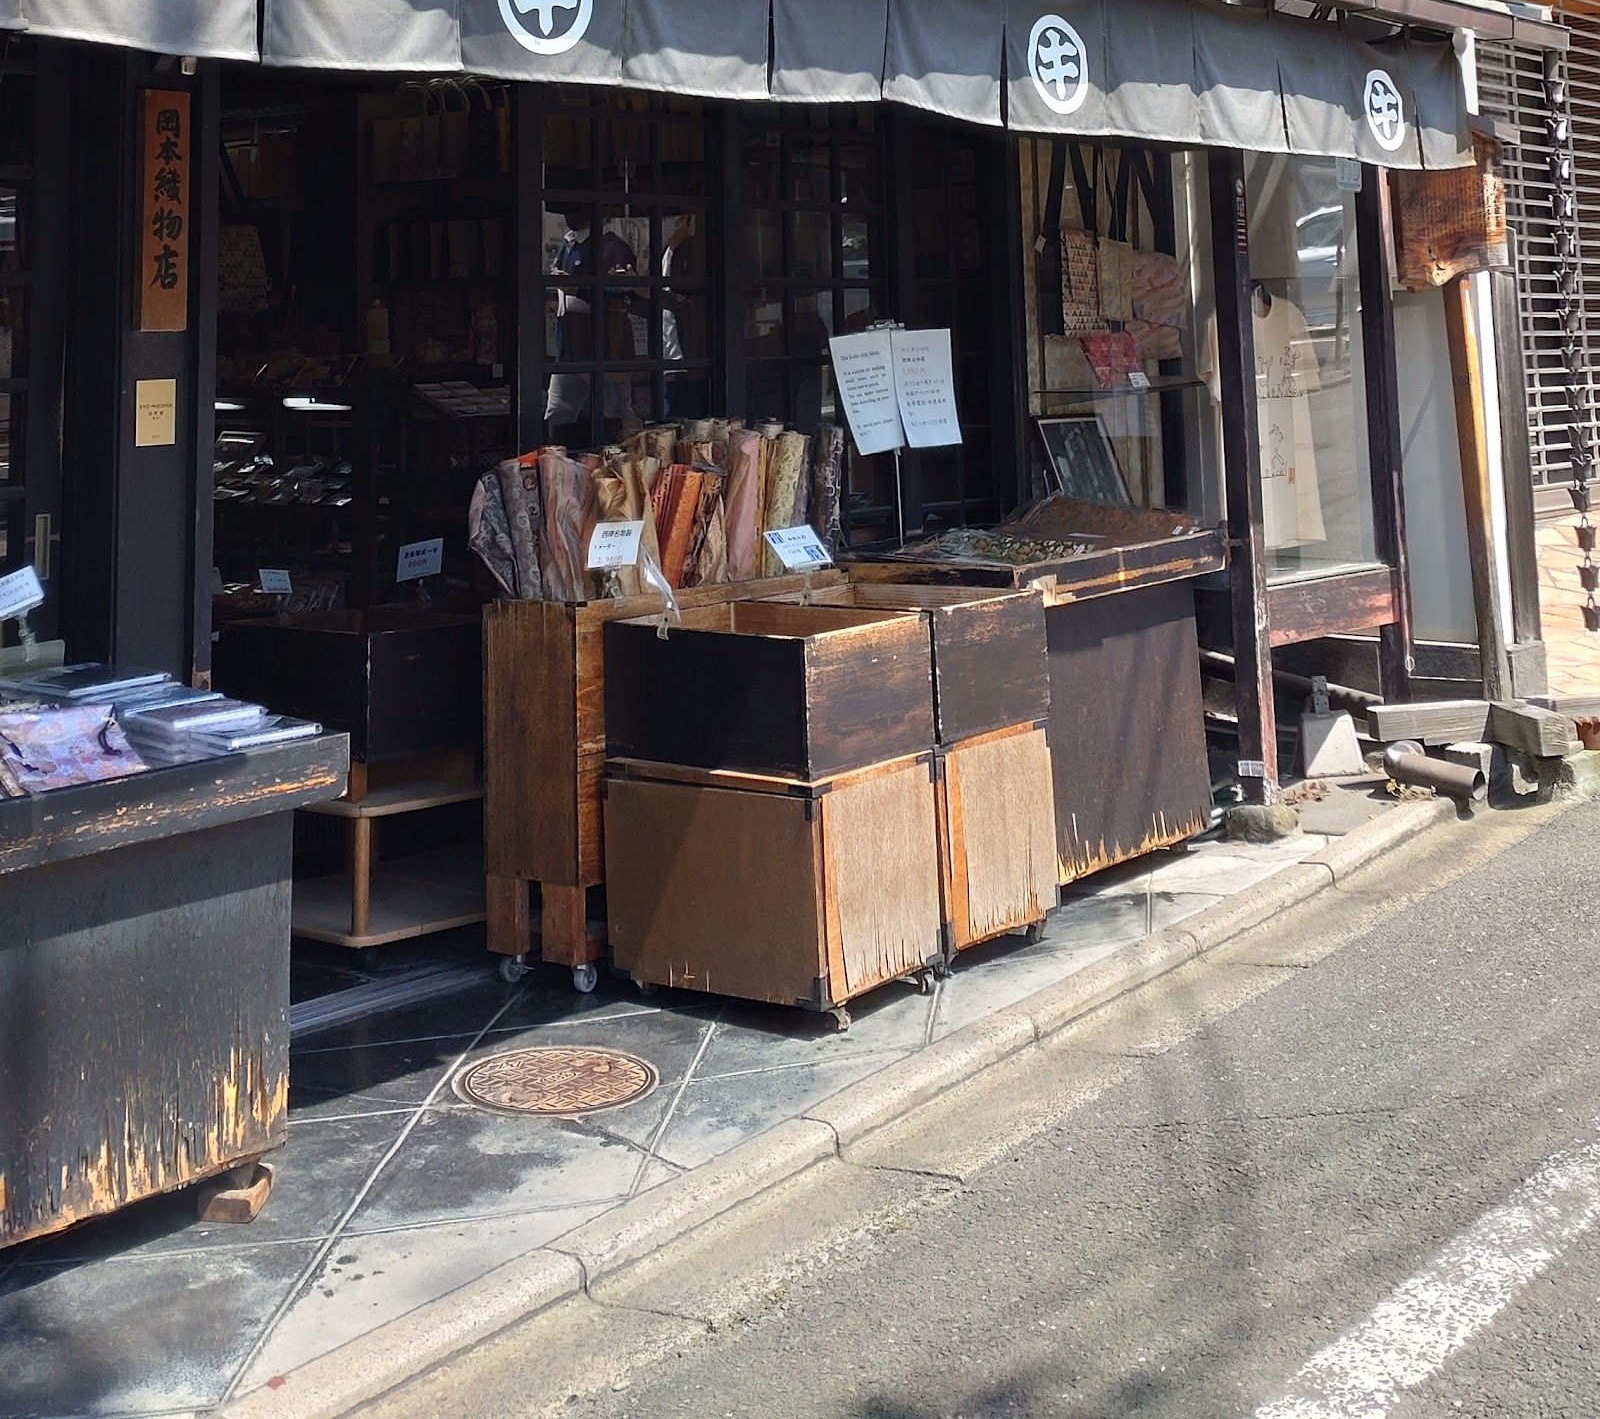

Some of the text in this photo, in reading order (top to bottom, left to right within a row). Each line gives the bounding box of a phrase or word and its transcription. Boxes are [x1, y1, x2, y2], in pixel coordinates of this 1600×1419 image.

[150, 108, 183, 290] 岡本織物店
